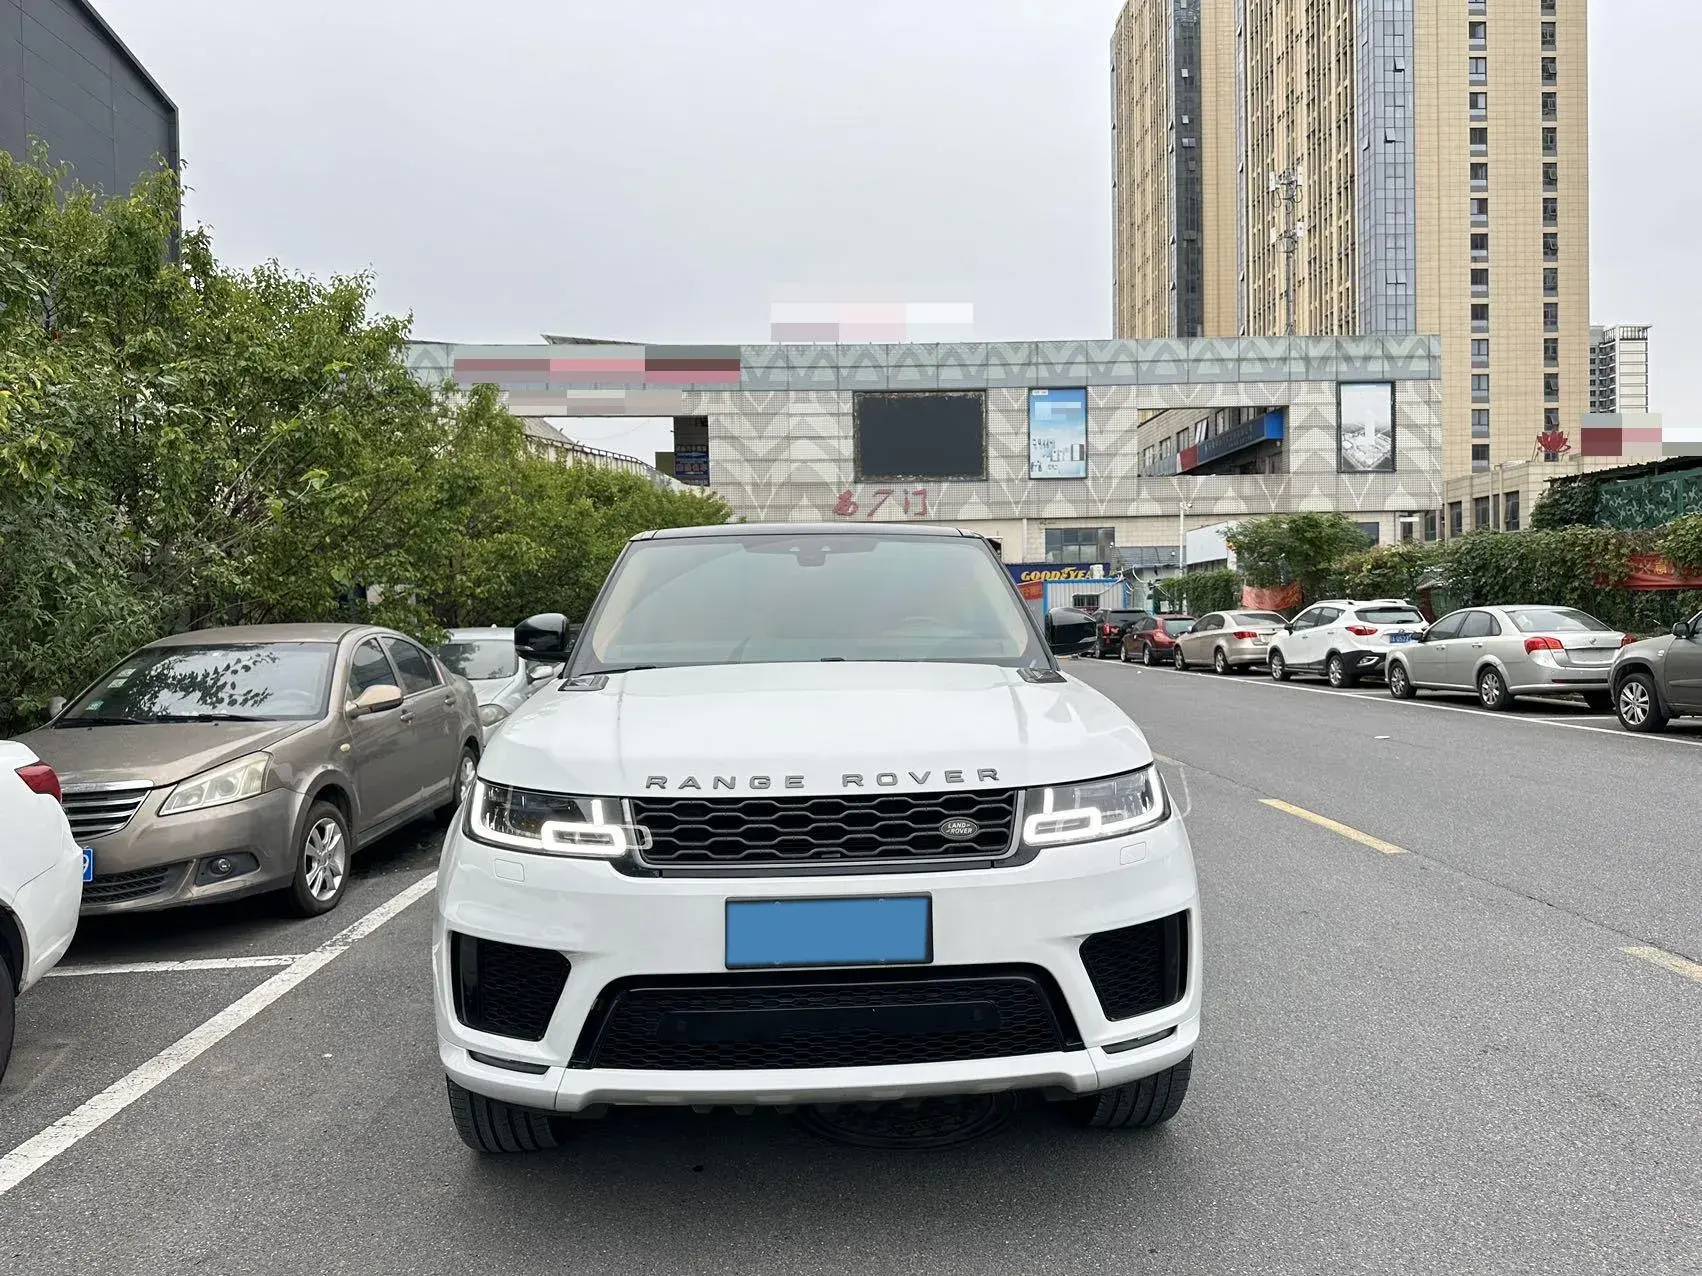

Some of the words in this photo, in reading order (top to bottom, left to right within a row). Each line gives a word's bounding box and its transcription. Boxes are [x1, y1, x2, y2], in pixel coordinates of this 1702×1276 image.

[1020, 567, 1094, 581] GOODYEA
[645, 774, 805, 790] RANGE
[841, 768, 1000, 788] ROVER
